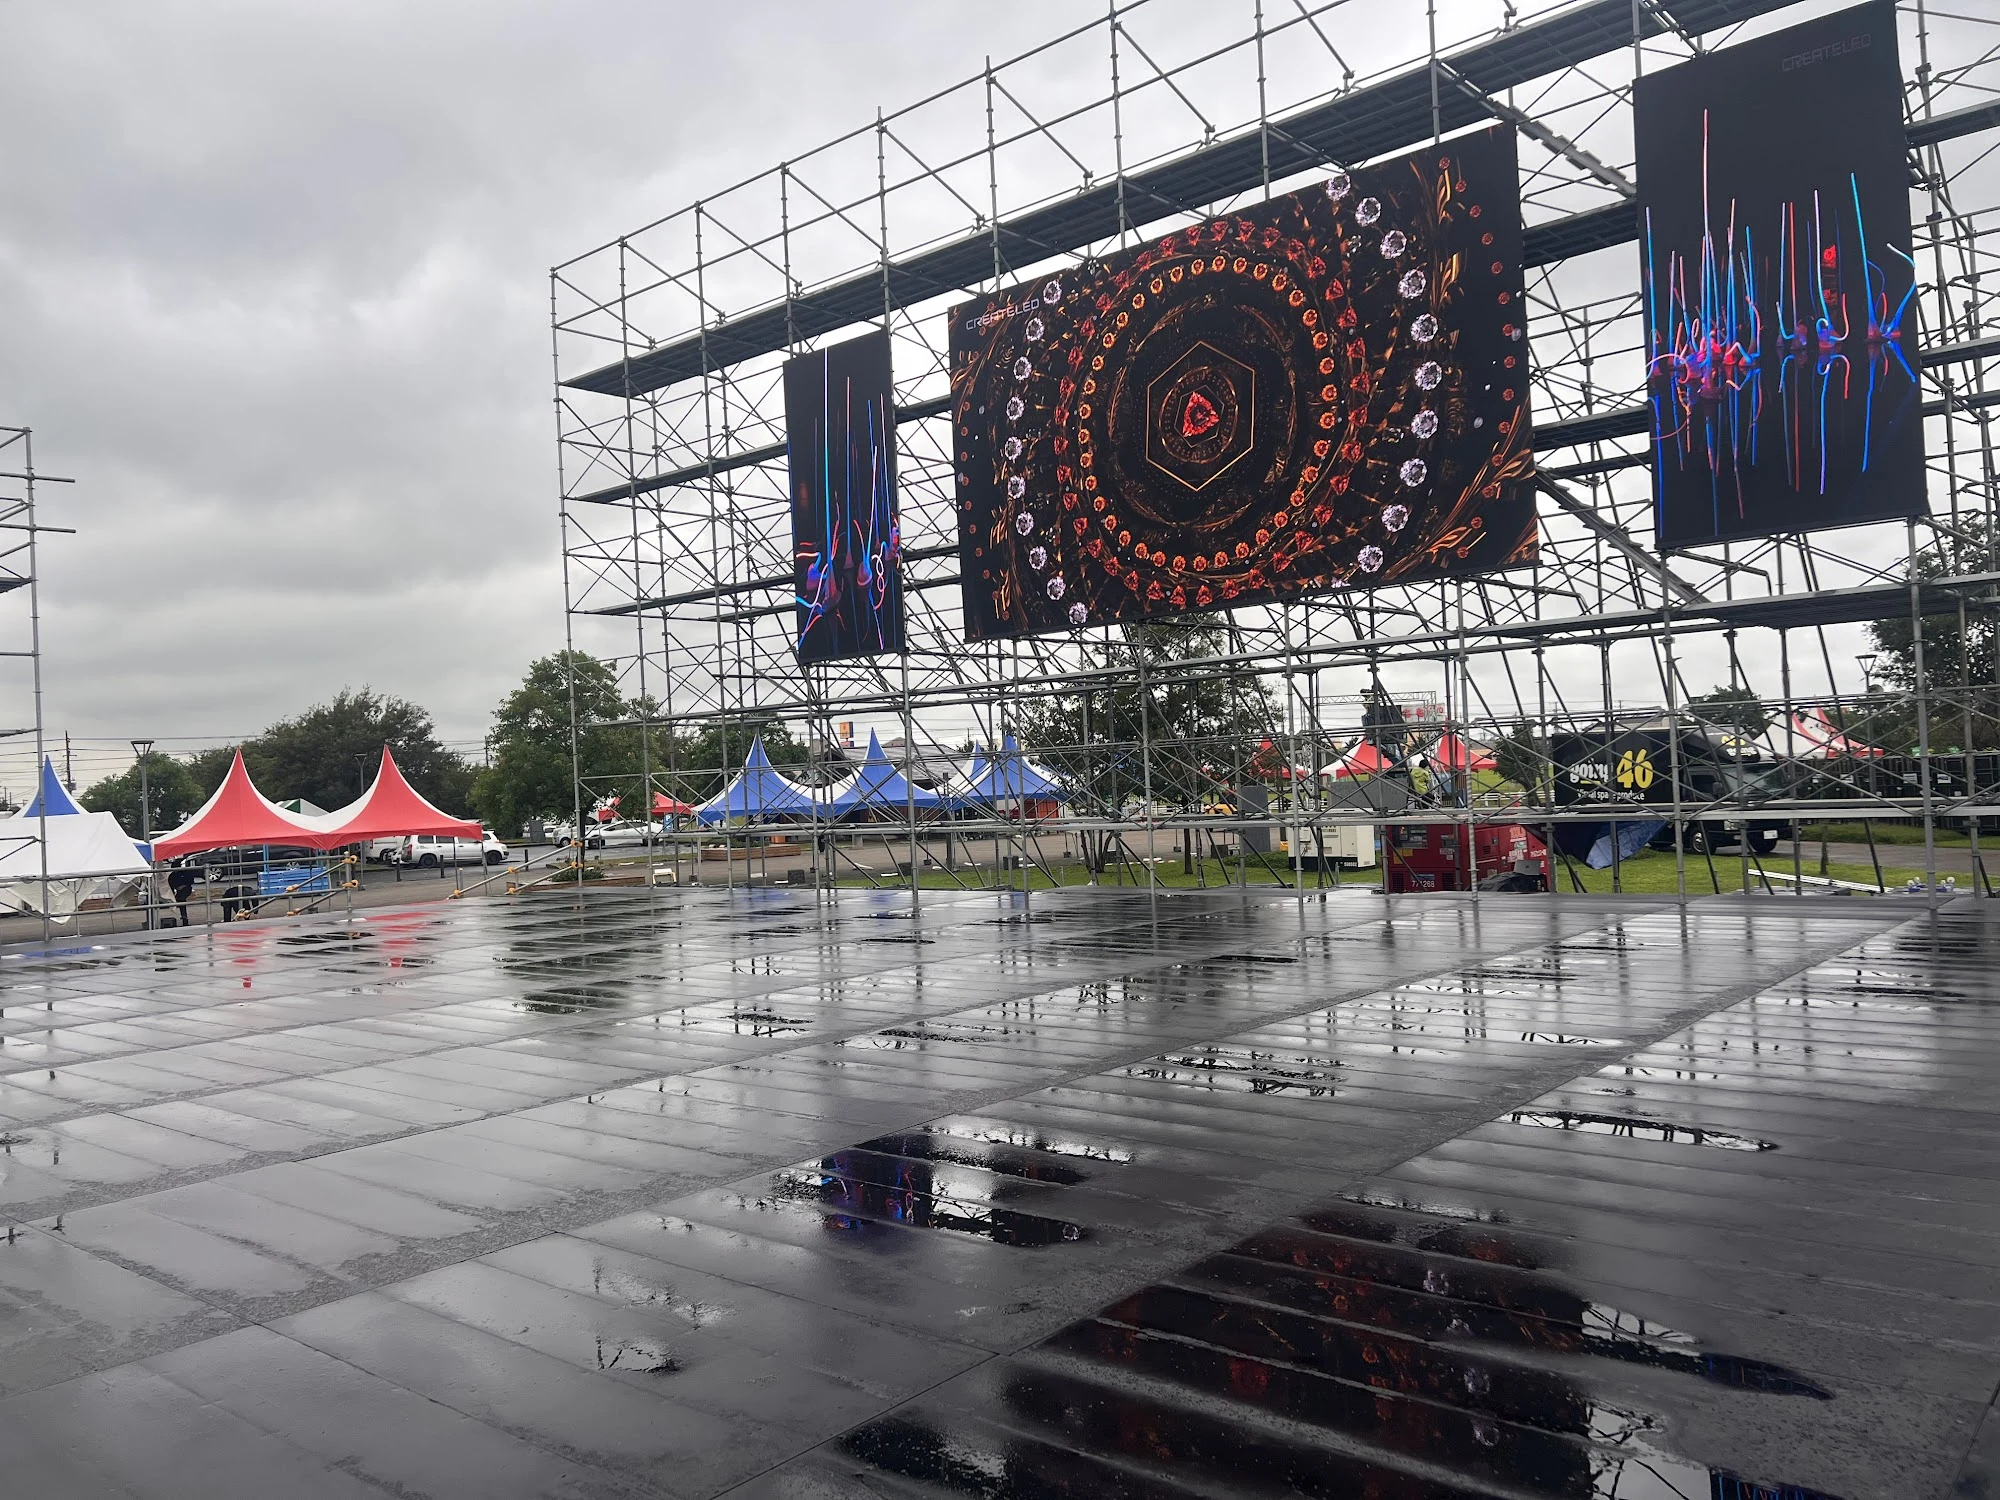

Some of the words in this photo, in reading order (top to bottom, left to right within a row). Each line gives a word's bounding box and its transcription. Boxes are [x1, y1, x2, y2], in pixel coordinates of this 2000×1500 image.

[1782, 33, 1871, 71] CREATELED
[966, 298, 1040, 330] CREATELED
[1616, 748, 1654, 789] 46
[1597, 791, 1616, 801] spae
